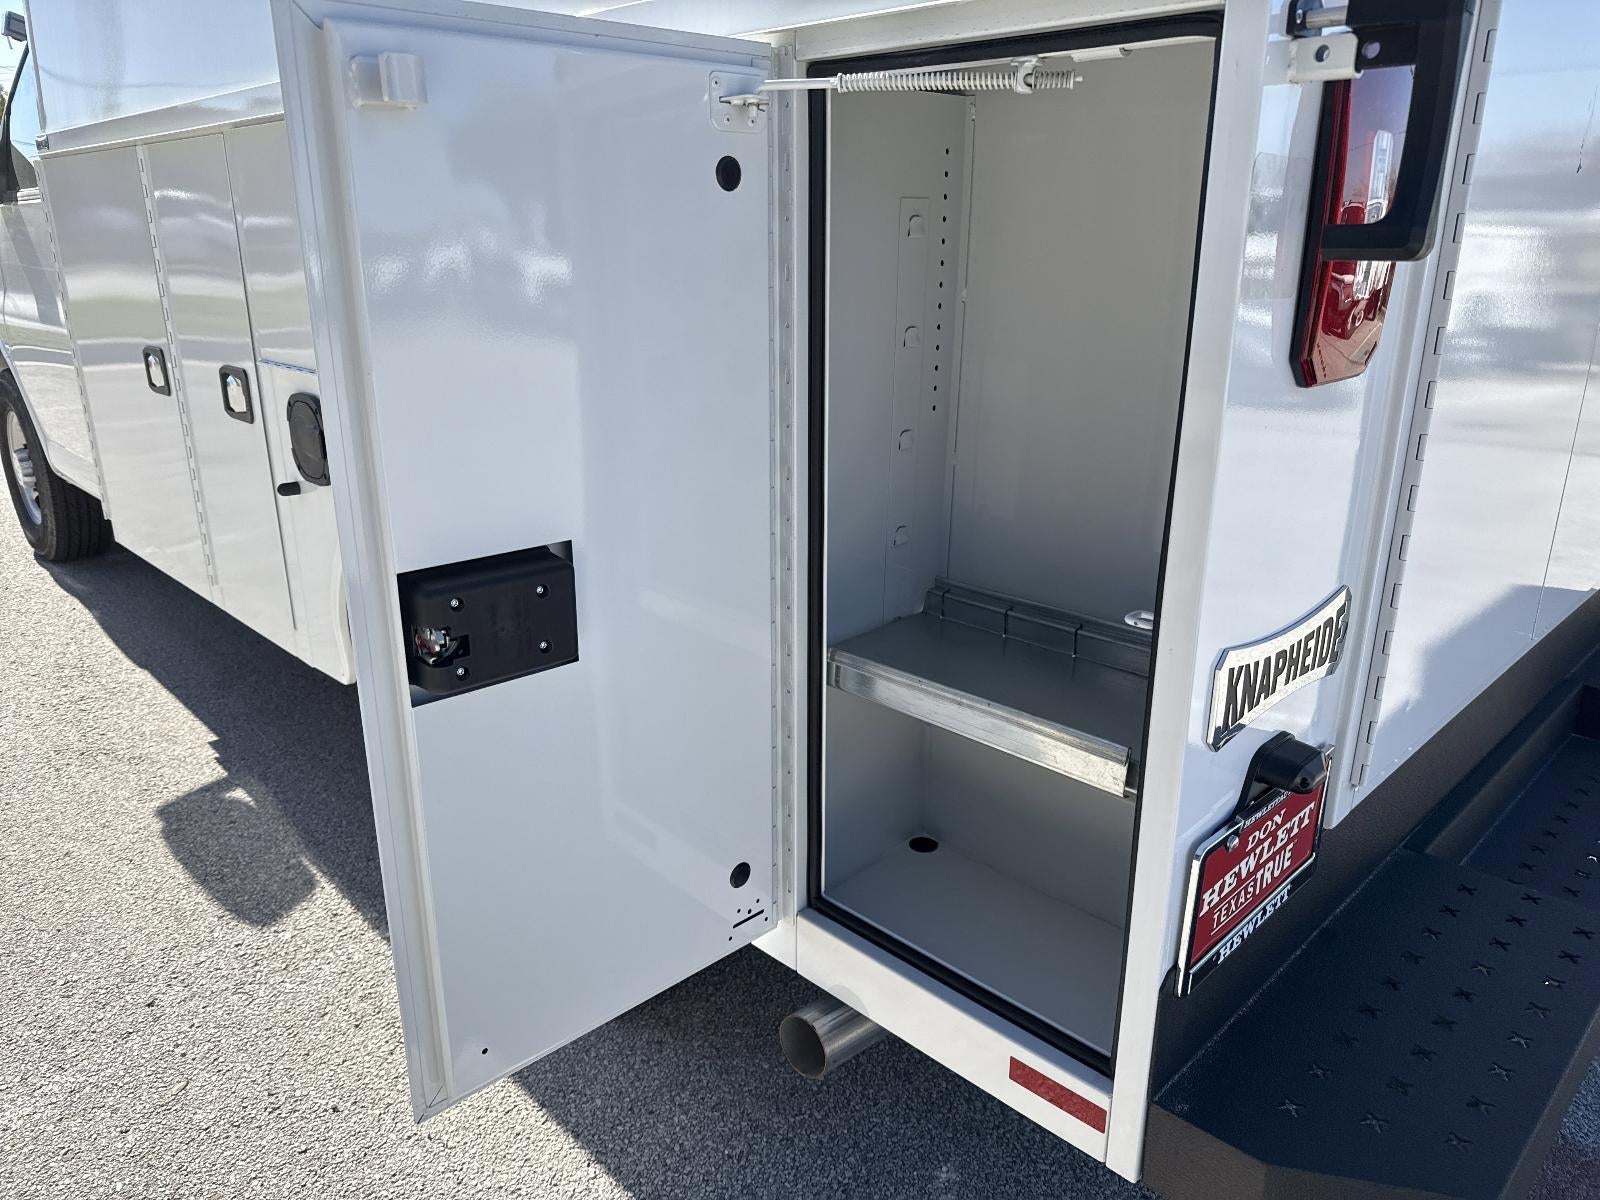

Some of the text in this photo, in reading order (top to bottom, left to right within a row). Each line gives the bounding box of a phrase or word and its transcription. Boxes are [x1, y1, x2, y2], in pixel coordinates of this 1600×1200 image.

[1222, 601, 1347, 730] KNAPHEIDE
[1199, 801, 1316, 918] HEWLETT
[1246, 808, 1286, 851] DON
[1217, 884, 1291, 965] HEWLETT
